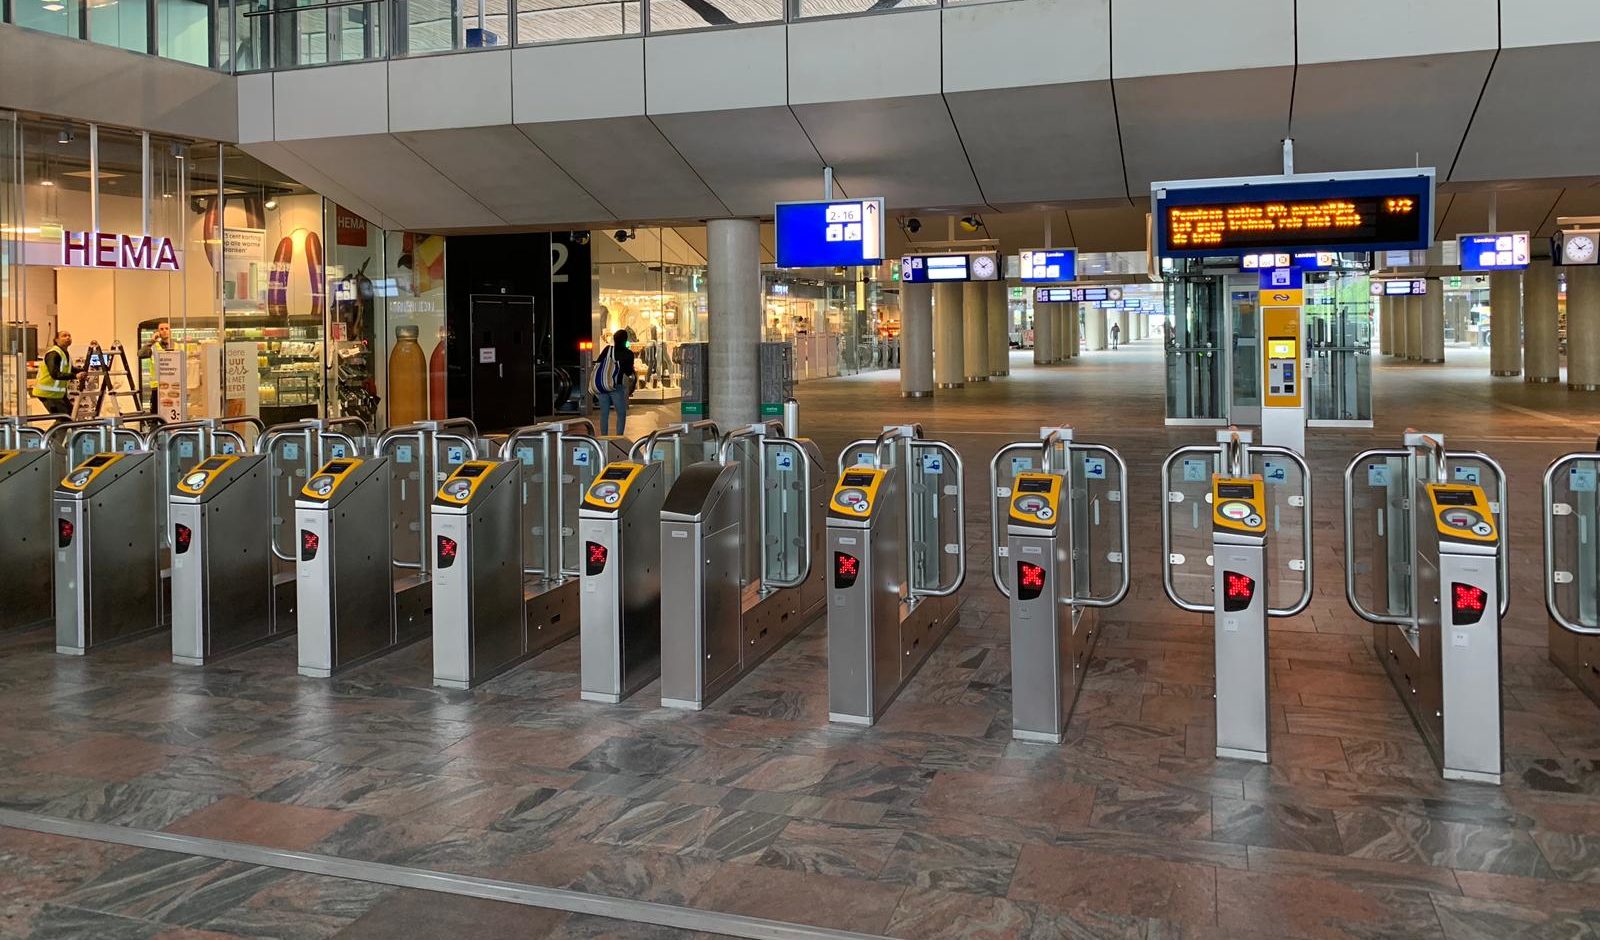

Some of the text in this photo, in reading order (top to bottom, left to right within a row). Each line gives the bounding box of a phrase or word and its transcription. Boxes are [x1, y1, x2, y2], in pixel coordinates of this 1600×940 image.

[338, 216, 365, 230] HEMA
[1307, 216, 1331, 227] niet
[1336, 214, 1361, 226] met
[1173, 234, 1188, 243] de
[62, 230, 179, 270] HEMA
[551, 243, 568, 282] 2
